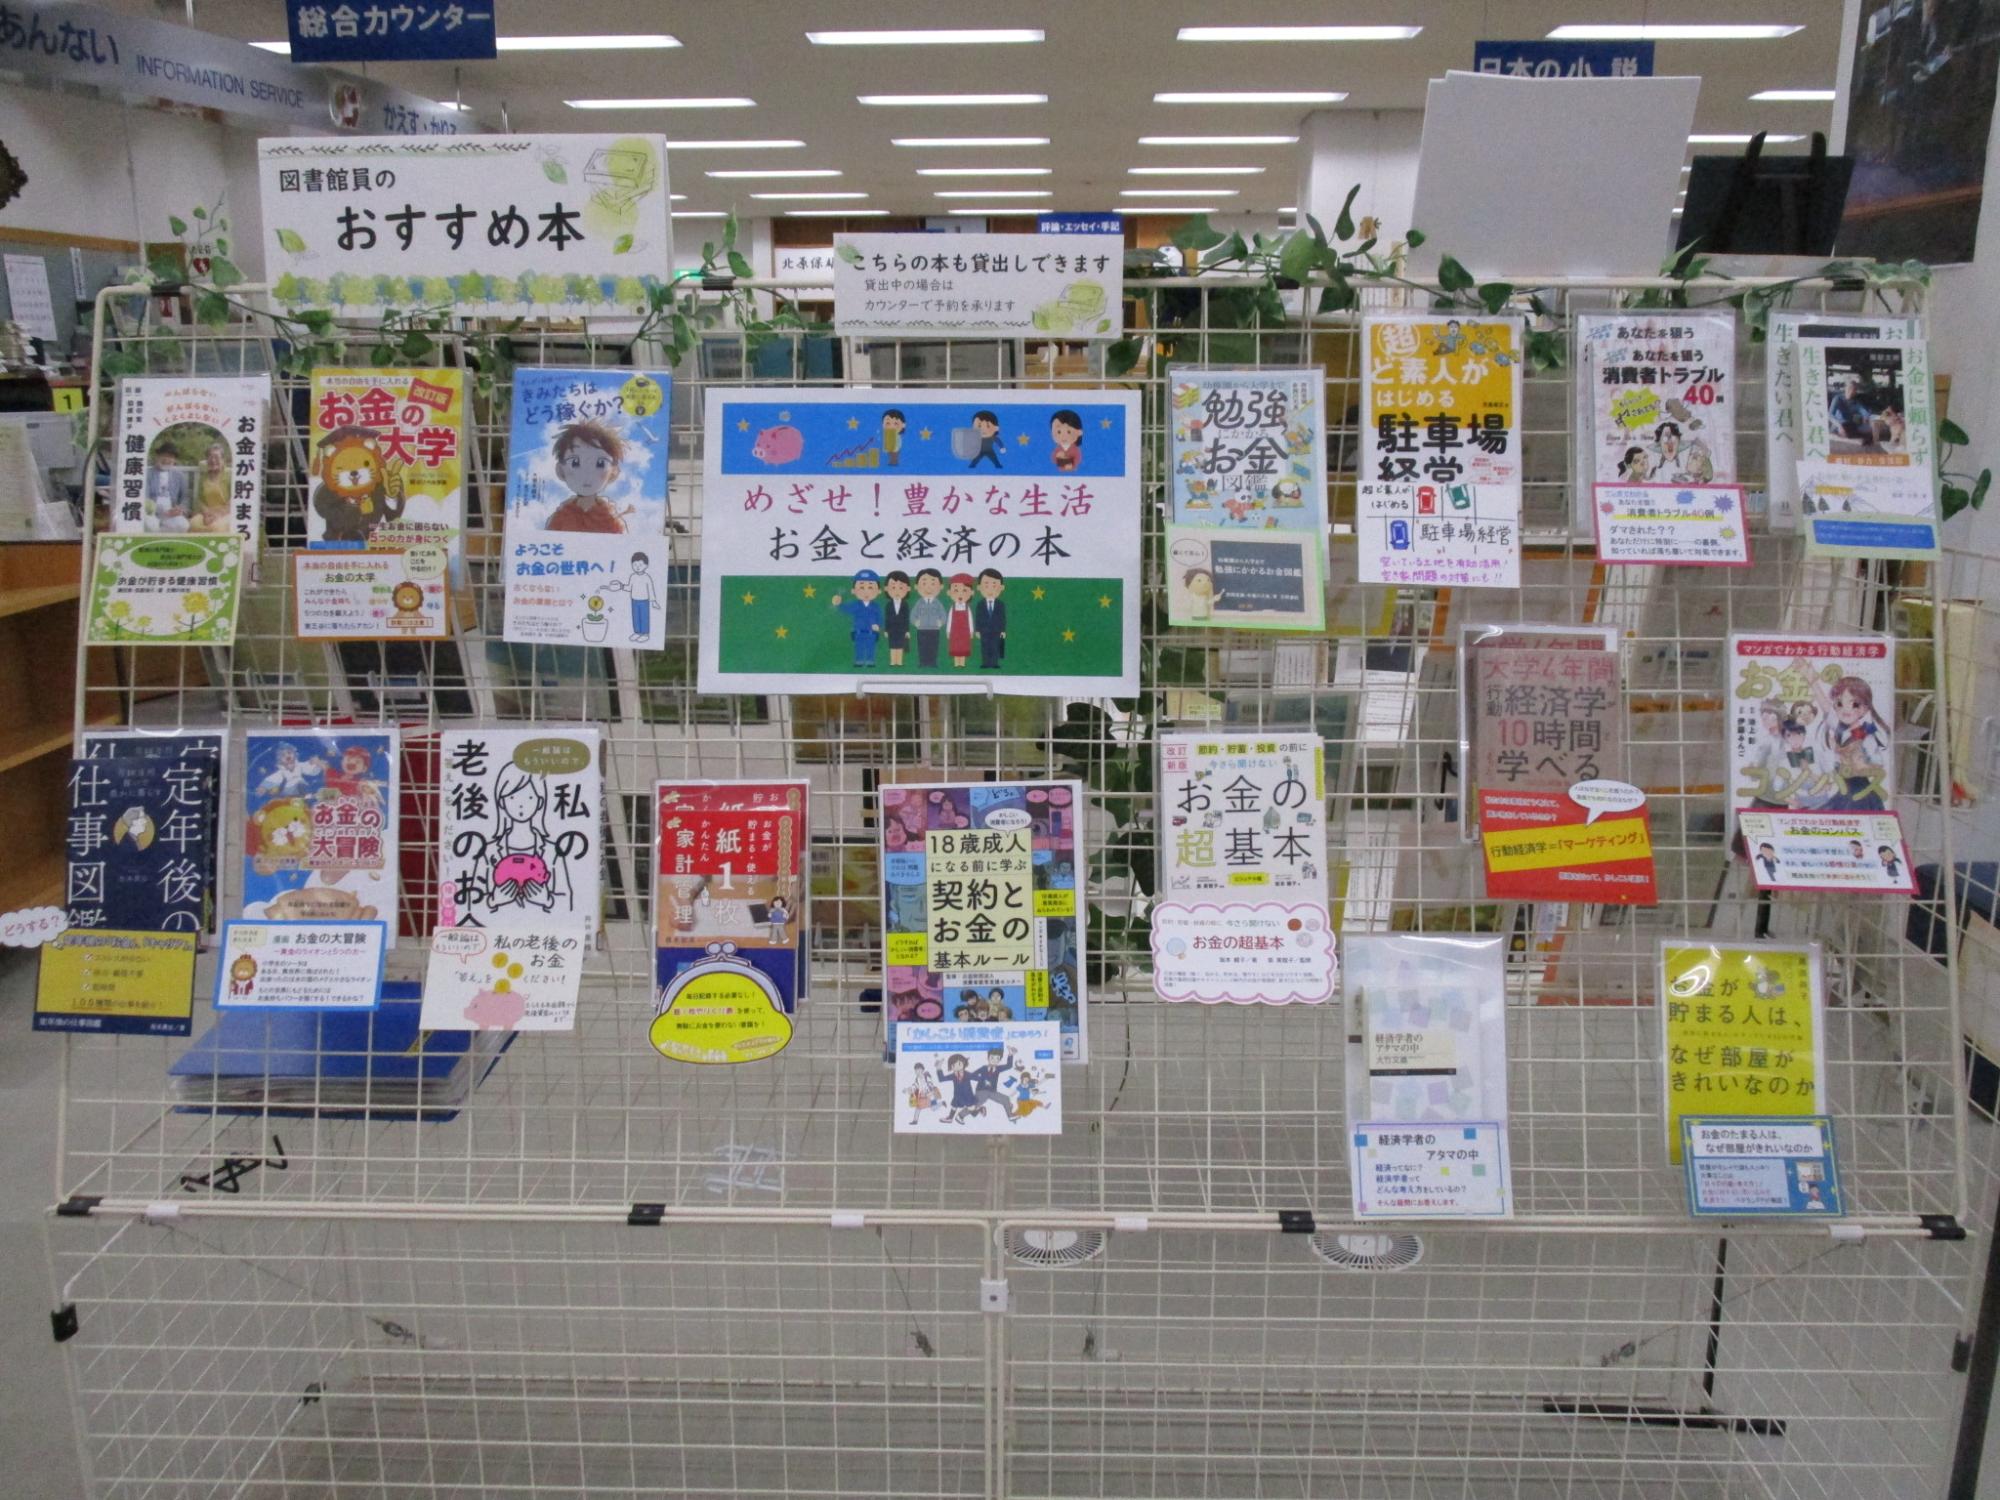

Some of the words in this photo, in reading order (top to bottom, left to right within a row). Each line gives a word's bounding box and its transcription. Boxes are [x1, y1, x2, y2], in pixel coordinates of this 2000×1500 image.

[297, 4, 490, 38] 総合カウンター
[0, 6, 119, 65] あんない
[136, 54, 245, 96] INFORMATION
[250, 79, 304, 109] SERVICE
[279, 168, 396, 193] 図書館員の
[336, 202, 586, 252] おすすめ本
[1041, 219, 1120, 233] 評論・エッセイ・手記
[852, 252, 1110, 275] こちらの本も貸出しできます
[864, 278, 954, 292] 貸出中の場合は
[863, 299, 1016, 312] カウンターで予約を承ります
[1616, 326, 1695, 339] あなたを狙う
[1632, 349, 1704, 362] あなたを狙う
[1372, 356, 1489, 385] ど素人が
[1602, 365, 1725, 384] 消費者トラブル
[1774, 322, 1794, 443] 生きたい君へ
[62, 395, 73, 410] 1
[521, 383, 598, 403] きみたちは
[1376, 389, 1456, 408] はじめる
[1802, 346, 1826, 459] 生きたい君へ
[318, 386, 425, 430] お金の
[525, 396, 625, 425] どう稼ぐか？
[1202, 388, 1289, 436] 勉強
[1906, 347, 1928, 466] お金に頼らず
[1376, 411, 1509, 454] 駐車場
[377, 426, 456, 467] 大学
[1202, 437, 1289, 475] お金
[122, 433, 146, 522] 健康習慣
[1377, 455, 1464, 483] 経営
[744, 482, 1095, 518] めざせ！豊かな生活
[1361, 484, 1411, 495] 超ど素人が
[1371, 500, 1409, 510] はじめる
[768, 523, 1072, 567] お金と経済の本
[1420, 520, 1512, 546] 駐車場経営
[515, 543, 564, 556] ようこそ
[325, 573, 376, 583] お金の大学
[516, 560, 616, 576] お金の世界へ！
[117, 576, 218, 586] お金が貯まる健康習慣
[1742, 644, 1880, 657] マンガでわかる行動経済学
[1735, 657, 1844, 703] お金の
[1486, 685, 1503, 717] 行動
[1504, 684, 1606, 718] 経済学
[1498, 718, 1601, 752] 10時間
[1166, 746, 1188, 756] 改訂
[1167, 760, 1187, 770] 新版
[1209, 758, 1278, 770] 今さら聞けない
[1496, 749, 1600, 782] 学べる
[1177, 774, 1308, 814] お金の
[1736, 765, 1889, 802] コンパス
[314, 803, 381, 828] お金の
[553, 783, 591, 860] 私の
[699, 820, 711, 862] かんたん
[761, 820, 773, 853] お金が
[1790, 826, 1861, 836] お金のコンパス
[312, 836, 380, 858] 大冒険
[930, 832, 1027, 855] 18歳成人
[1175, 826, 1312, 869] 超基本
[673, 828, 695, 925] 家計管理
[715, 827, 742, 925] 紙1枚
[930, 858, 1027, 873] になる前に学ぶ
[931, 878, 1024, 912] 契約と
[4, 915, 60, 937] どうする？
[933, 912, 1030, 944] お金の
[295, 932, 367, 945] お金の大冒険
[494, 934, 578, 952] 私の老後の
[1192, 934, 1286, 951] お金の超基本
[530, 953, 566, 969] お金
[933, 949, 1030, 969] 基本ルール
[1668, 1001, 1801, 1027] 貯まる人は、
[1375, 1032, 1424, 1044] 経済学者の
[1375, 1043, 1420, 1054] アタマの中
[1670, 1044, 1794, 1069] なぜ部屋が
[1671, 1071, 1815, 1097] きれいなのか
[1378, 1133, 1437, 1146] 経済学者の
[1701, 1129, 1782, 1140] お金のたまる人は、
[1426, 1149, 1479, 1161] アタマの中
[1705, 1143, 1813, 1154] なぜ部屋がきれいなのか
[1375, 1163, 1423, 1173] 経済ってなに？
[1376, 1174, 1421, 1183] 経済学者って
[1376, 1185, 1468, 1194] どんな考え方をしているの？
